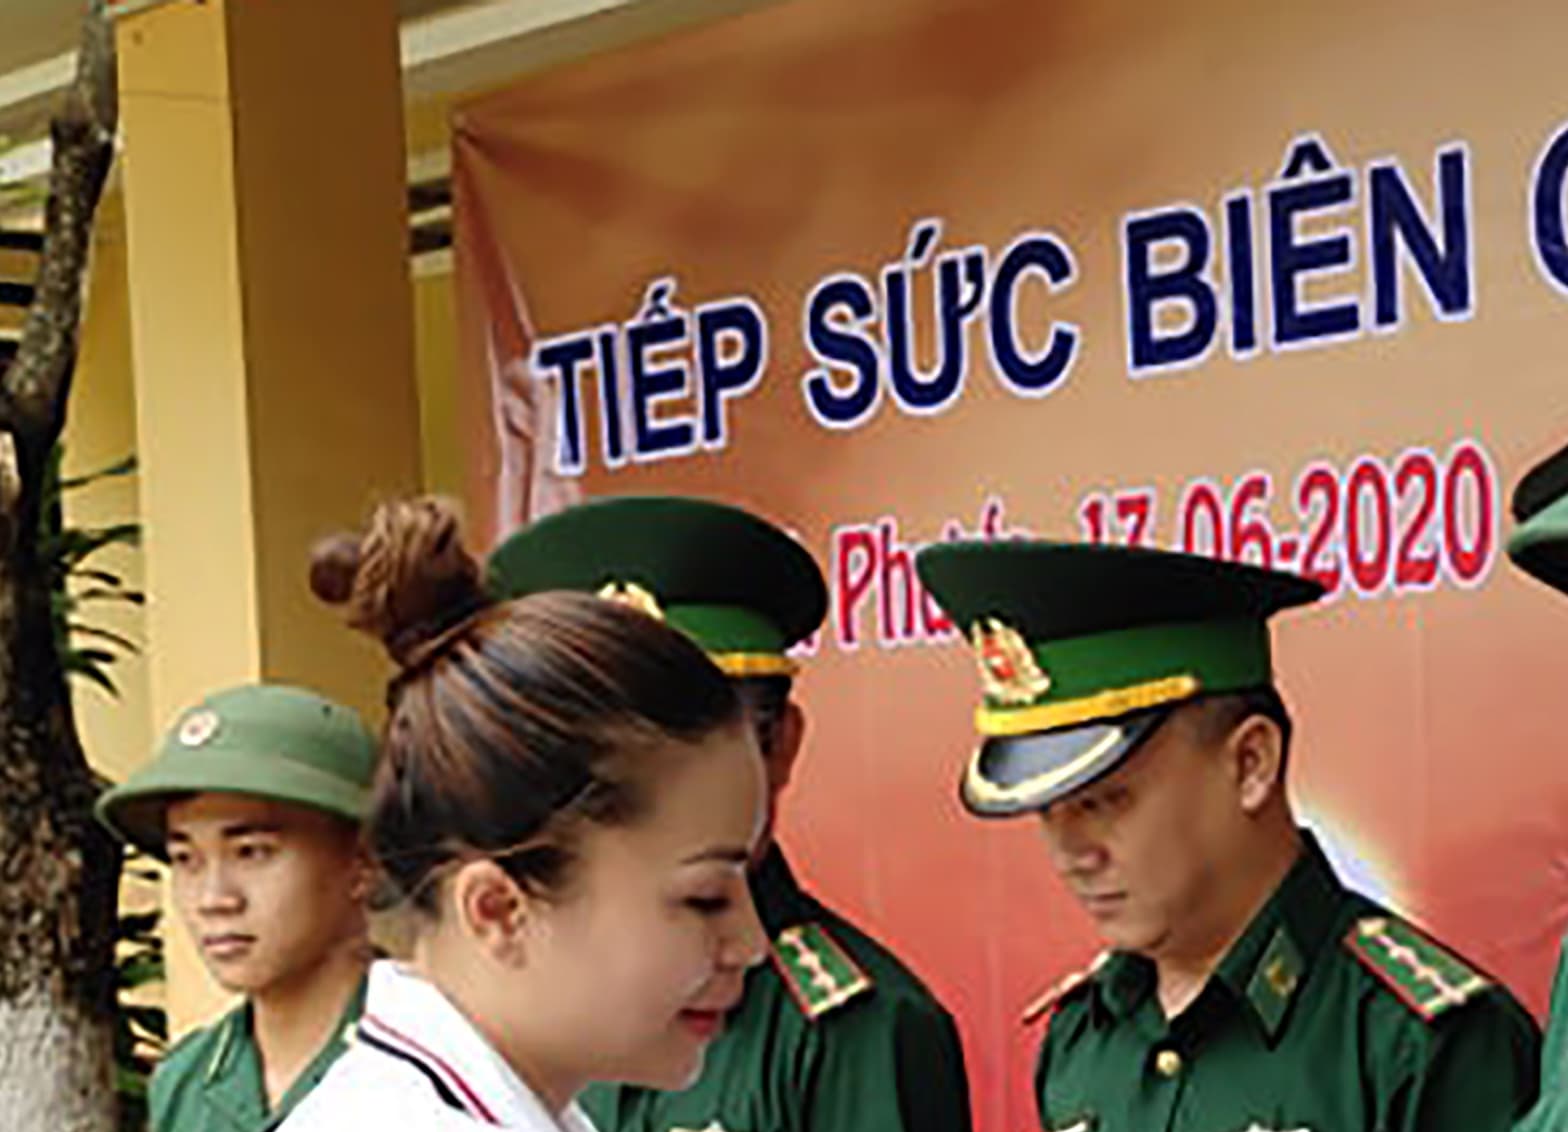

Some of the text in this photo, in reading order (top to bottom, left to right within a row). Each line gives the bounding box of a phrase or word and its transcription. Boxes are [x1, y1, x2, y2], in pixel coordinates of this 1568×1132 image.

[536, 281, 766, 470] TIẾP
[801, 225, 1078, 424] SỨC
[1123, 138, 1473, 371] BIÊN
